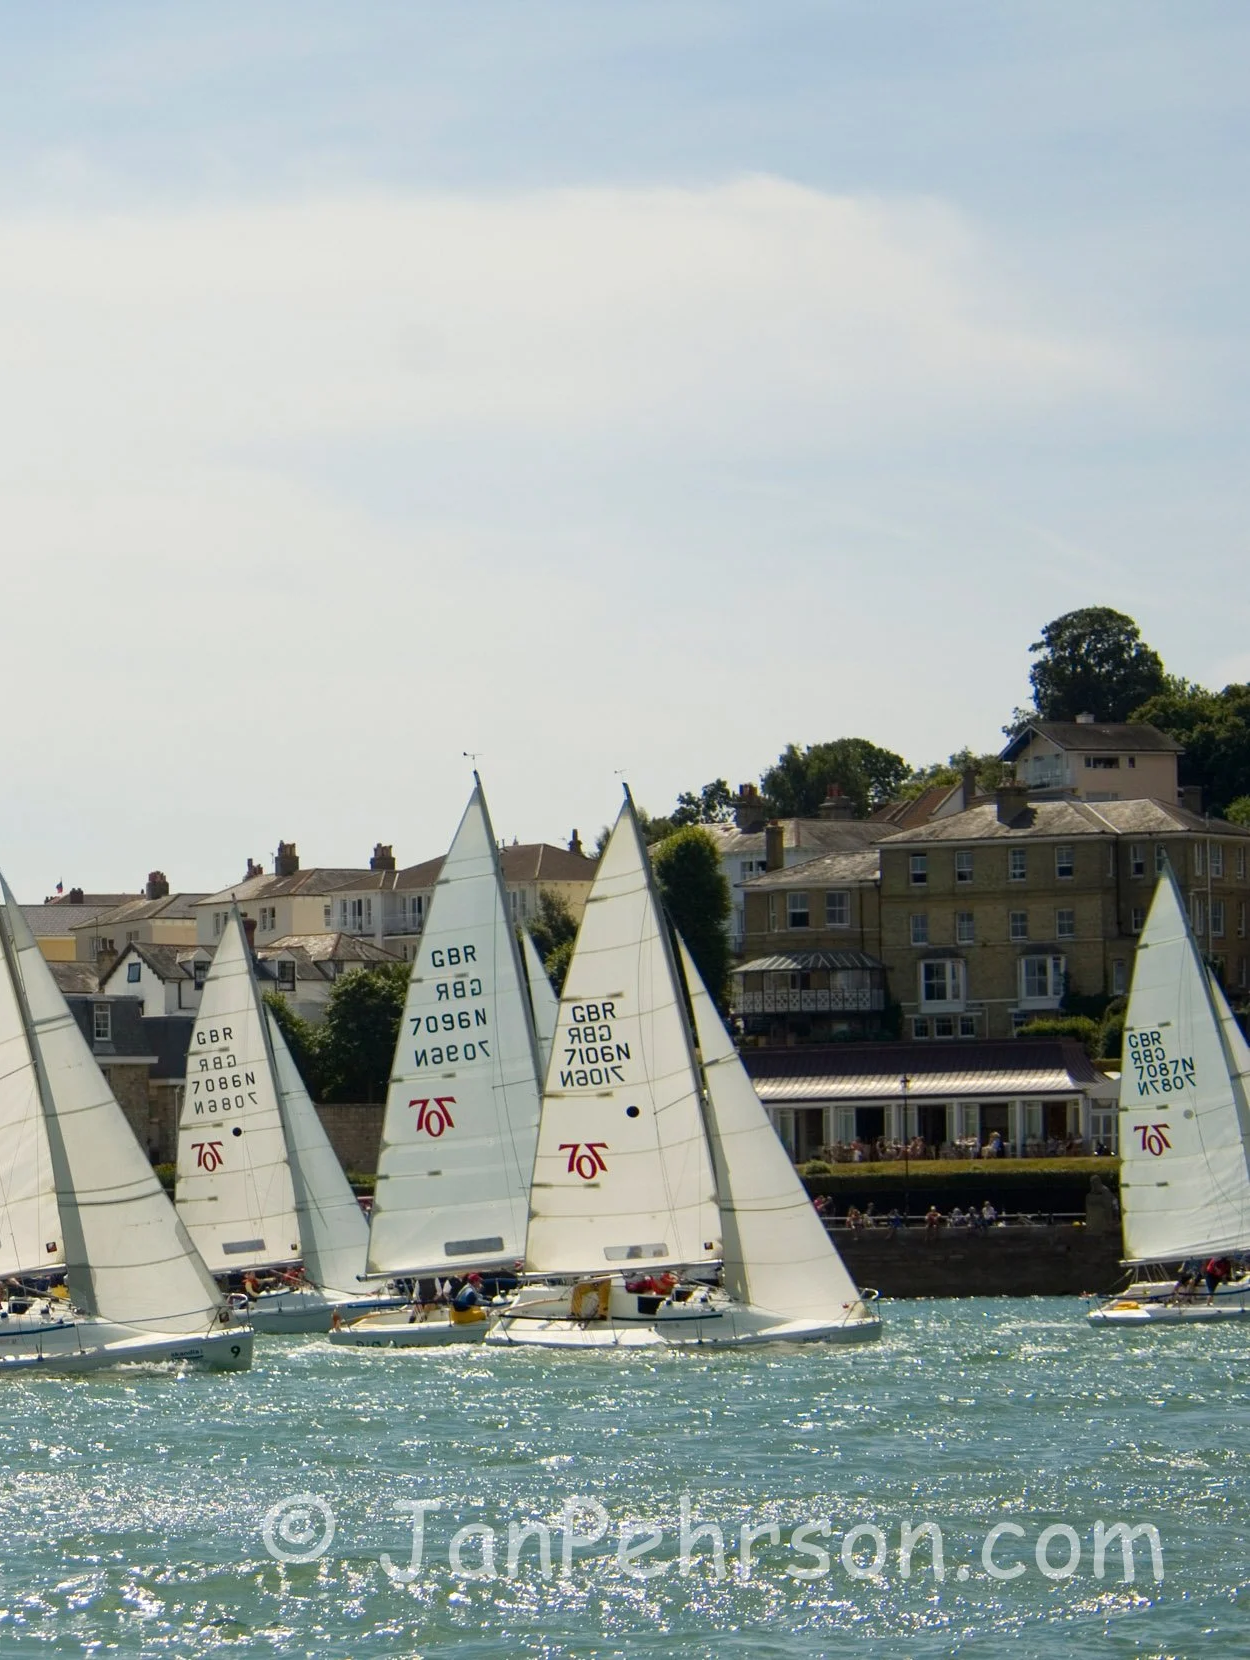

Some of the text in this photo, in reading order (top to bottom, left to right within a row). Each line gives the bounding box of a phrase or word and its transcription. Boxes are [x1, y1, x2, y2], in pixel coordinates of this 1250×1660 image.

[431, 945, 477, 967] GBR
[410, 1008, 487, 1036] 7096N
[572, 1002, 616, 1023] GBR
[196, 1027, 233, 1045] GBR
[1128, 1031, 1162, 1048] GBR
[564, 1043, 631, 1065] 7106N
[1134, 1057, 1194, 1080] 7087N
[192, 1071, 255, 1094] 7086N
[408, 1096, 457, 1137] 707
[1134, 1123, 1172, 1157] 707
[191, 1141, 224, 1172] 707
[558, 1142, 609, 1180] 707
[230, 1345, 241, 1359] 9
